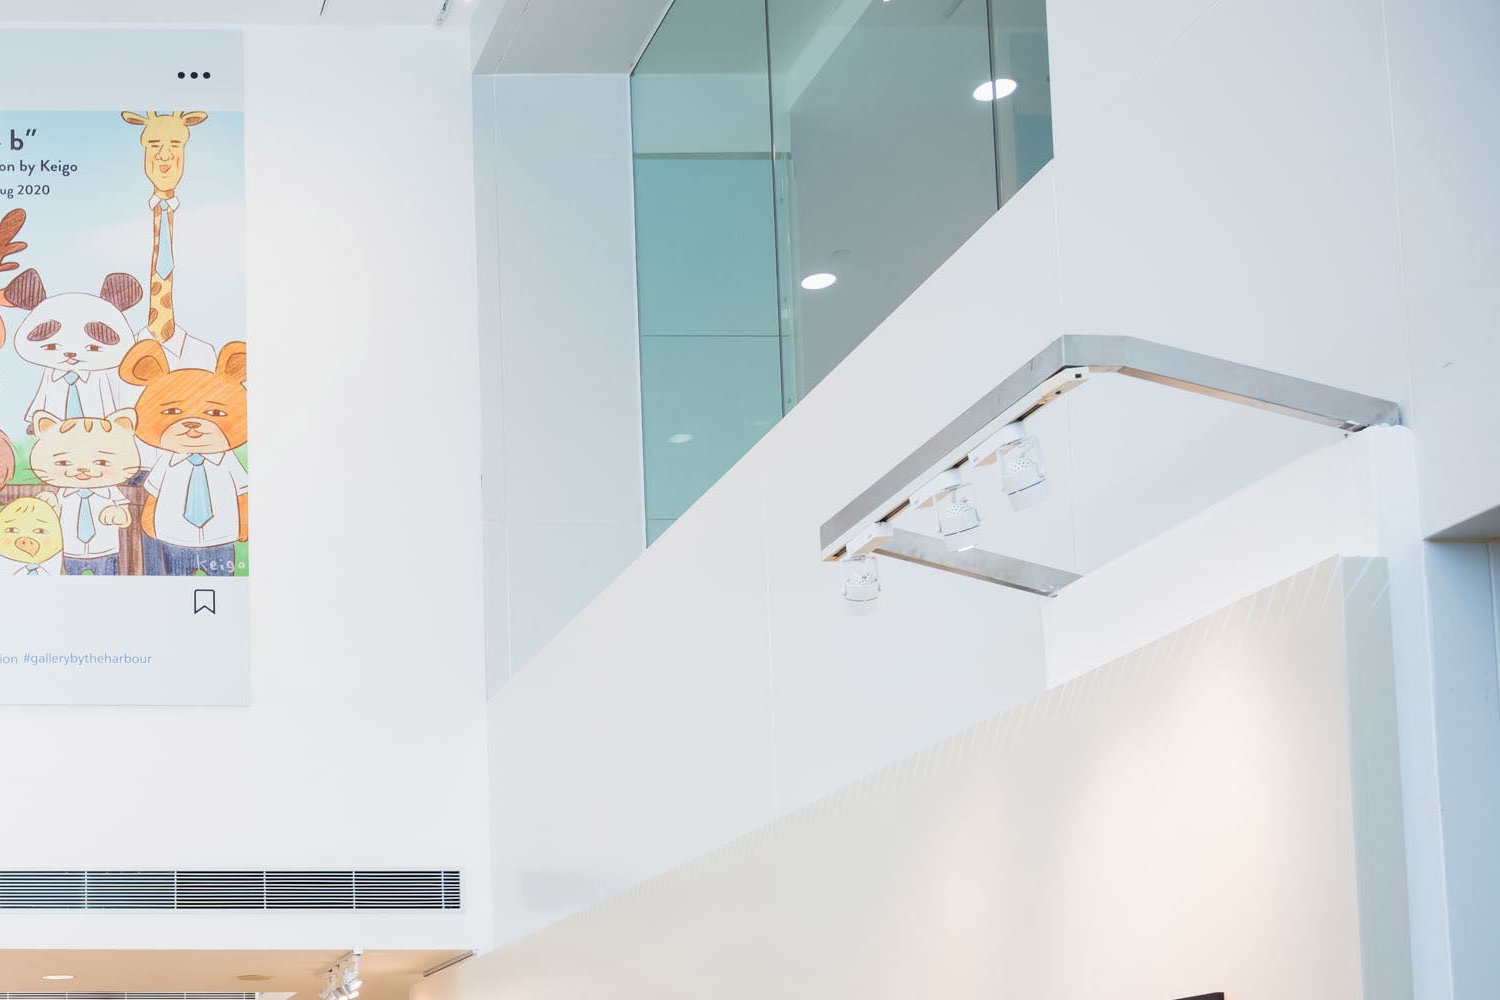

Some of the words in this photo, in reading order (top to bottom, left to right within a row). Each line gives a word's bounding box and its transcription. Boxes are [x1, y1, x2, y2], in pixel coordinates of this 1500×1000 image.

[19, 159, 35, 176] by
[40, 159, 77, 176] Keigo
[17, 184, 49, 195] 2020
[23, 652, 151, 665] #gallerybytheharbour
